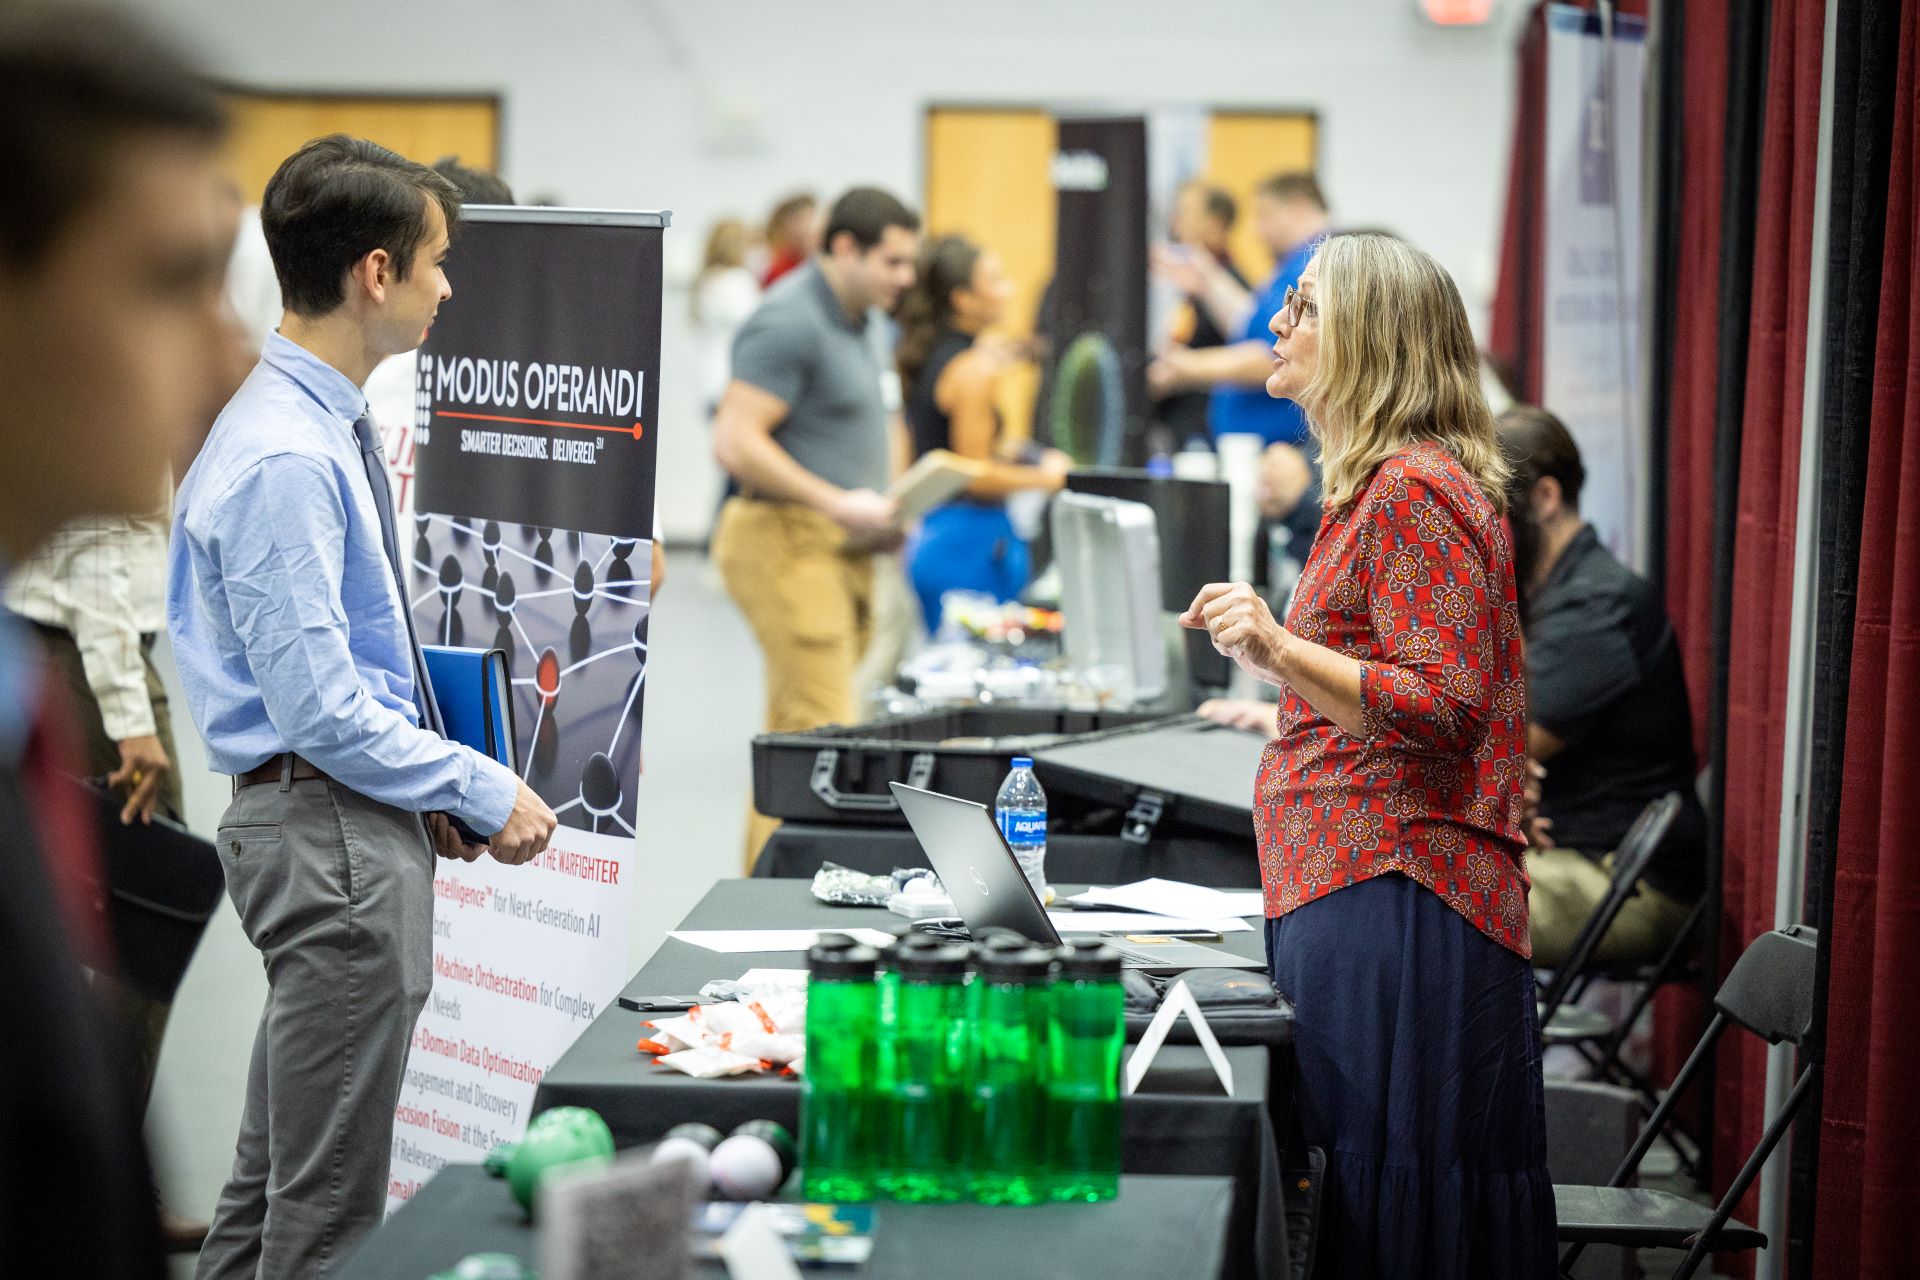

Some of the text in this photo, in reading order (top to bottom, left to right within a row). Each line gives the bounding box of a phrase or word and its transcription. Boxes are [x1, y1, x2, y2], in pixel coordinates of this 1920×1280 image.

[436, 355, 644, 418] MODUS OPERANDI
[461, 429, 501, 455] SMARTER
[502, 433, 549, 460] DECISIONS.
[552, 438, 596, 464] DELIVERED.
[542, 848, 557, 871] THE
[558, 850, 619, 885] WARFIGHTER
[433, 914, 452, 939] bric
[494, 888, 508, 913] for
[509, 892, 585, 936] Next-Generation
[587, 913, 601, 939] AI
[433, 991, 462, 1021] Needs
[475, 963, 538, 1004] Orchestration
[540, 981, 553, 1007] for
[554, 986, 596, 1021] Complex
[460, 1039, 481, 1068] Data
[482, 1046, 543, 1086] Optimization
[404, 1067, 519, 1125] nagement and Discovery
[396, 1101, 430, 1130] ecision
[431, 1108, 460, 1141] Fusion
[461, 1123, 472, 1146] at
[472, 1124, 488, 1151] the
